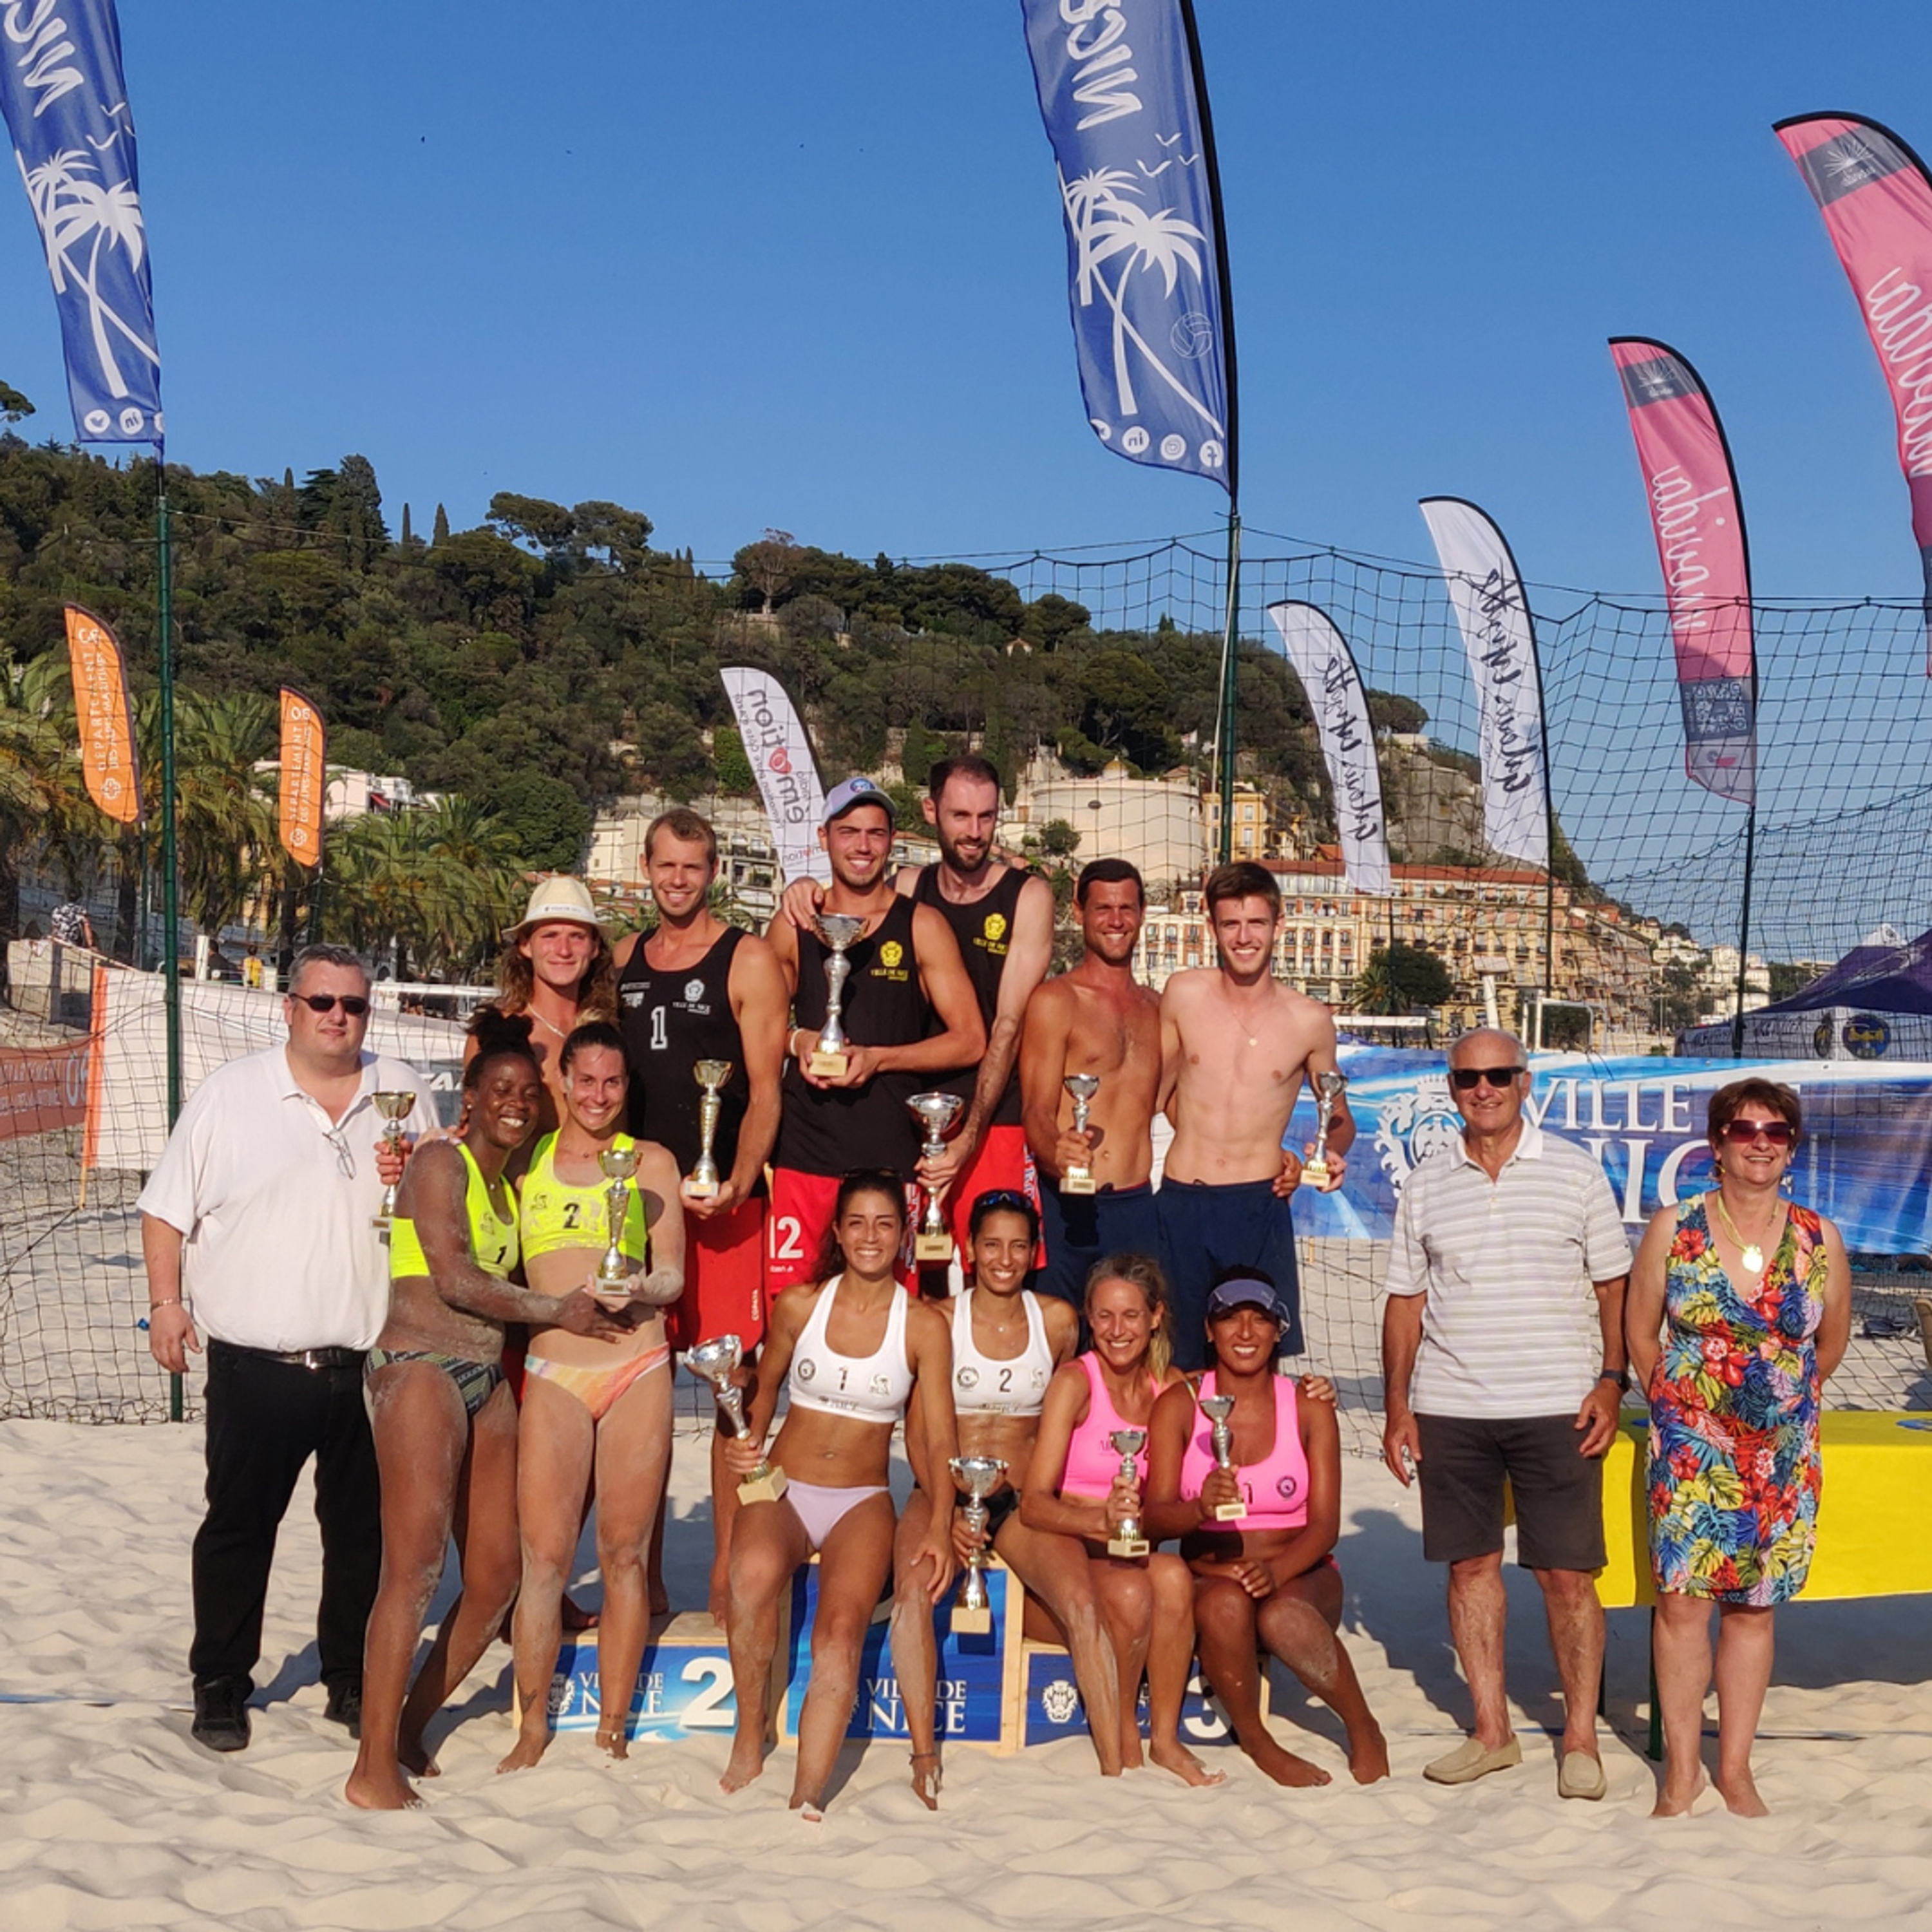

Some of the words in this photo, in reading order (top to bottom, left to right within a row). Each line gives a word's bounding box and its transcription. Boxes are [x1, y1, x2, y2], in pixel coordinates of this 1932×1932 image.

[650, 1006, 668, 1050] 1
[1525, 1077, 1692, 1132] VILLE
[563, 1202, 580, 1229] 2
[839, 1366, 848, 1391] 1
[999, 1368, 1012, 1392] 2
[679, 1656, 734, 1727] 2
[936, 1680, 967, 1700] DE
